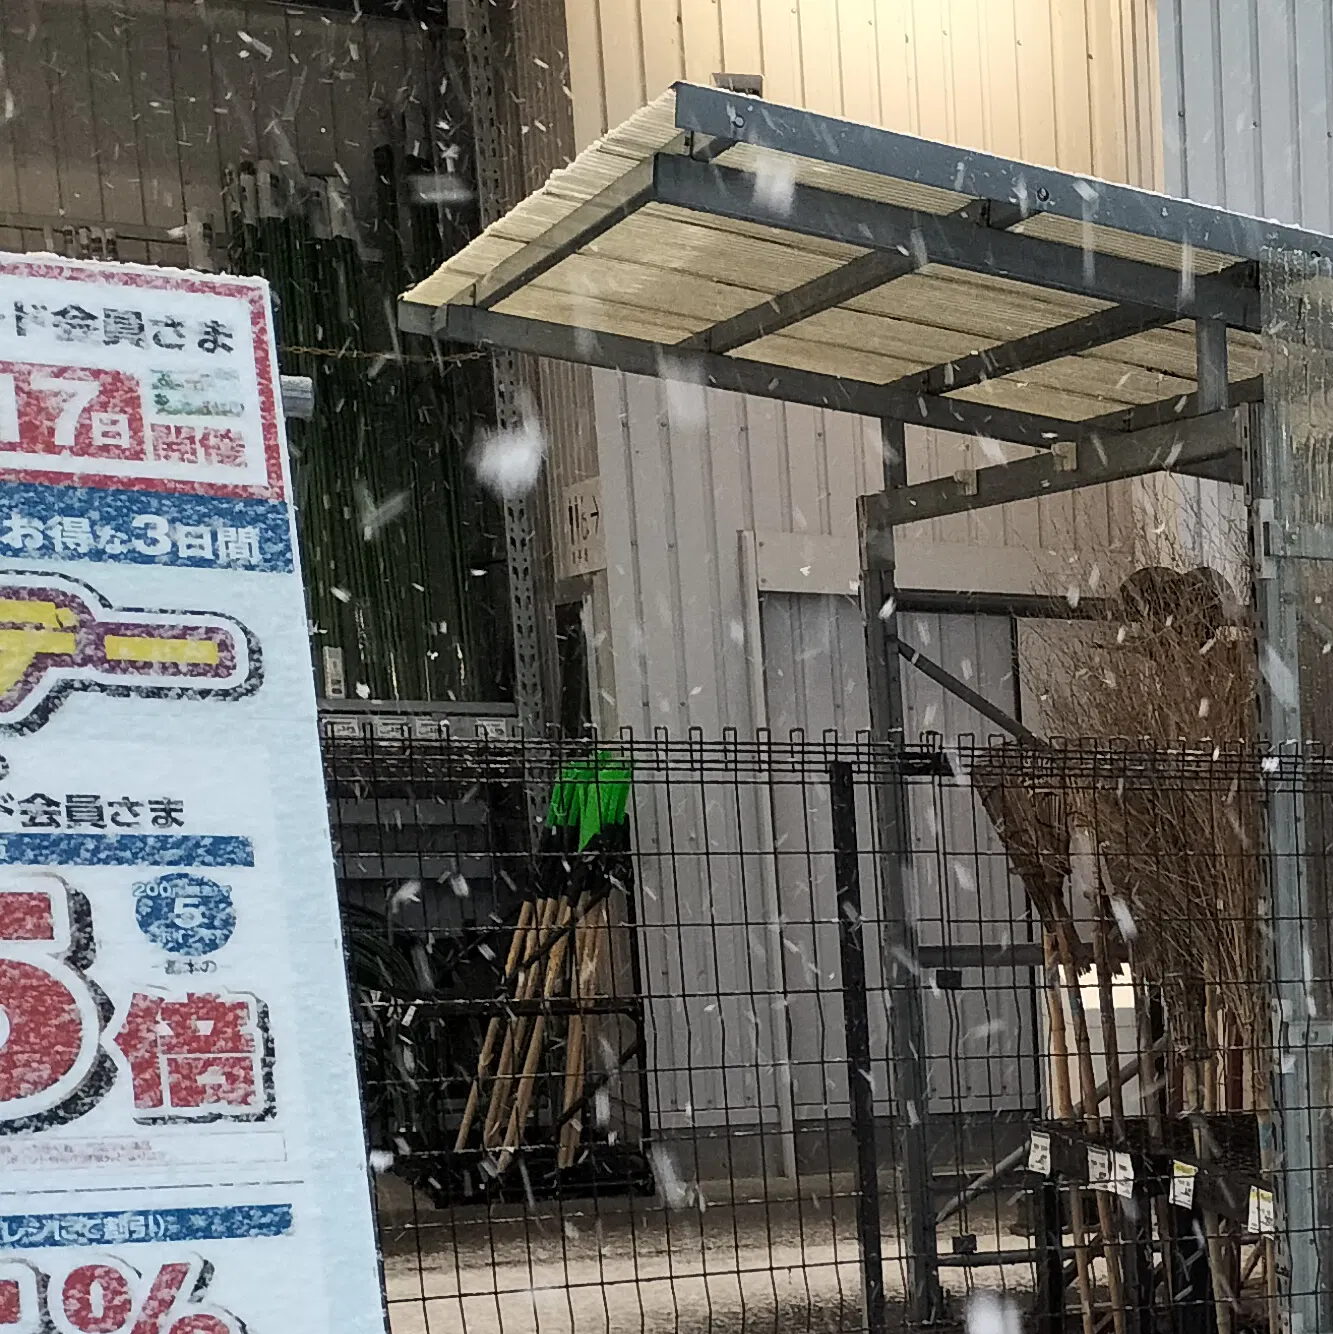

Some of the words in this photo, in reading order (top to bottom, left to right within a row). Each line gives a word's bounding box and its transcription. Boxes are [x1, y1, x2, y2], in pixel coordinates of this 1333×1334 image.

[0, 300, 235, 353] ド会員さま
[150, 422, 248, 468] 開催
[0, 512, 262, 565] お得な3日間
